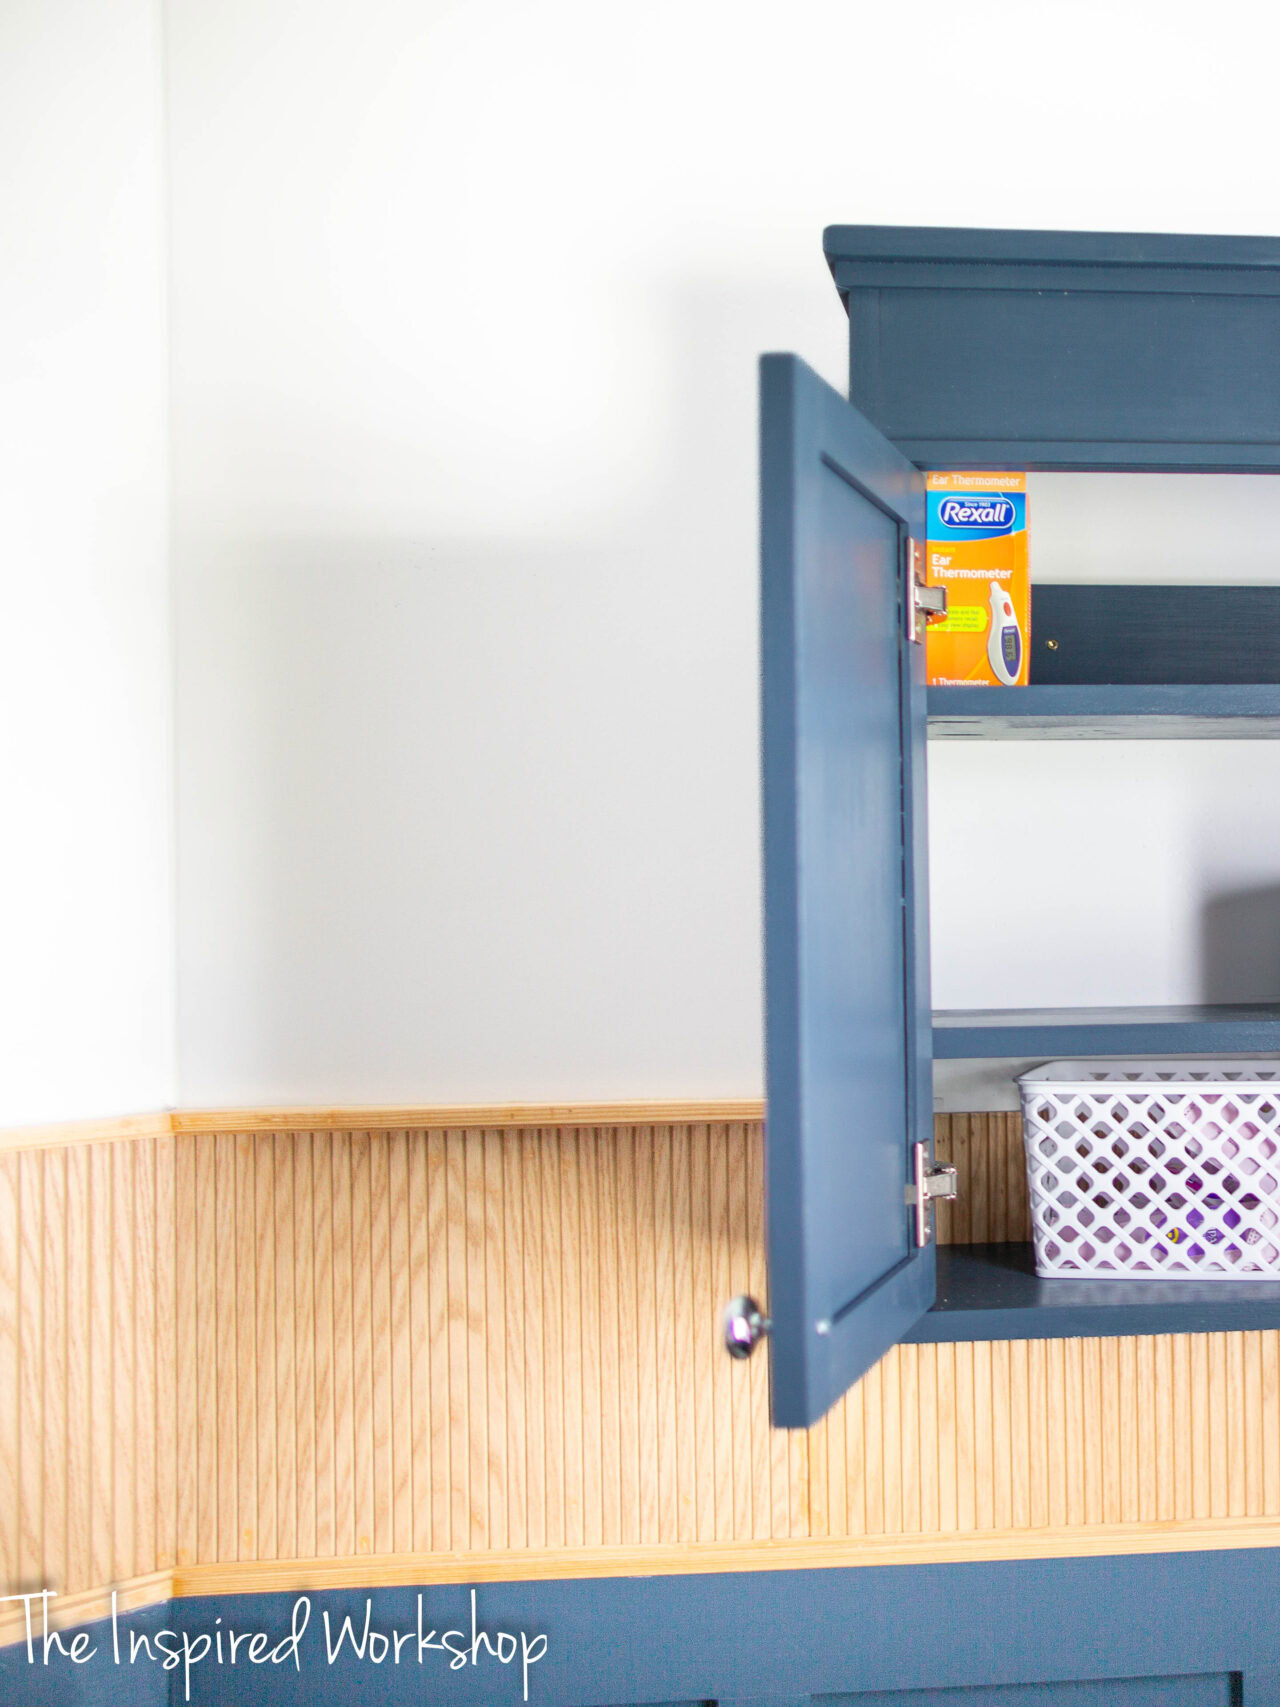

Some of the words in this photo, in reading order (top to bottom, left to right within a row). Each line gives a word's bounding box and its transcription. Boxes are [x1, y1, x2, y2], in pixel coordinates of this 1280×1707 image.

[932, 475, 949, 485] Ear
[952, 475, 1021, 487] Thermometer
[943, 502, 1006, 523] Rexall
[931, 554, 952, 566] Ear
[931, 566, 1013, 579] Thermometer
[938, 677, 990, 687] Thermometer
